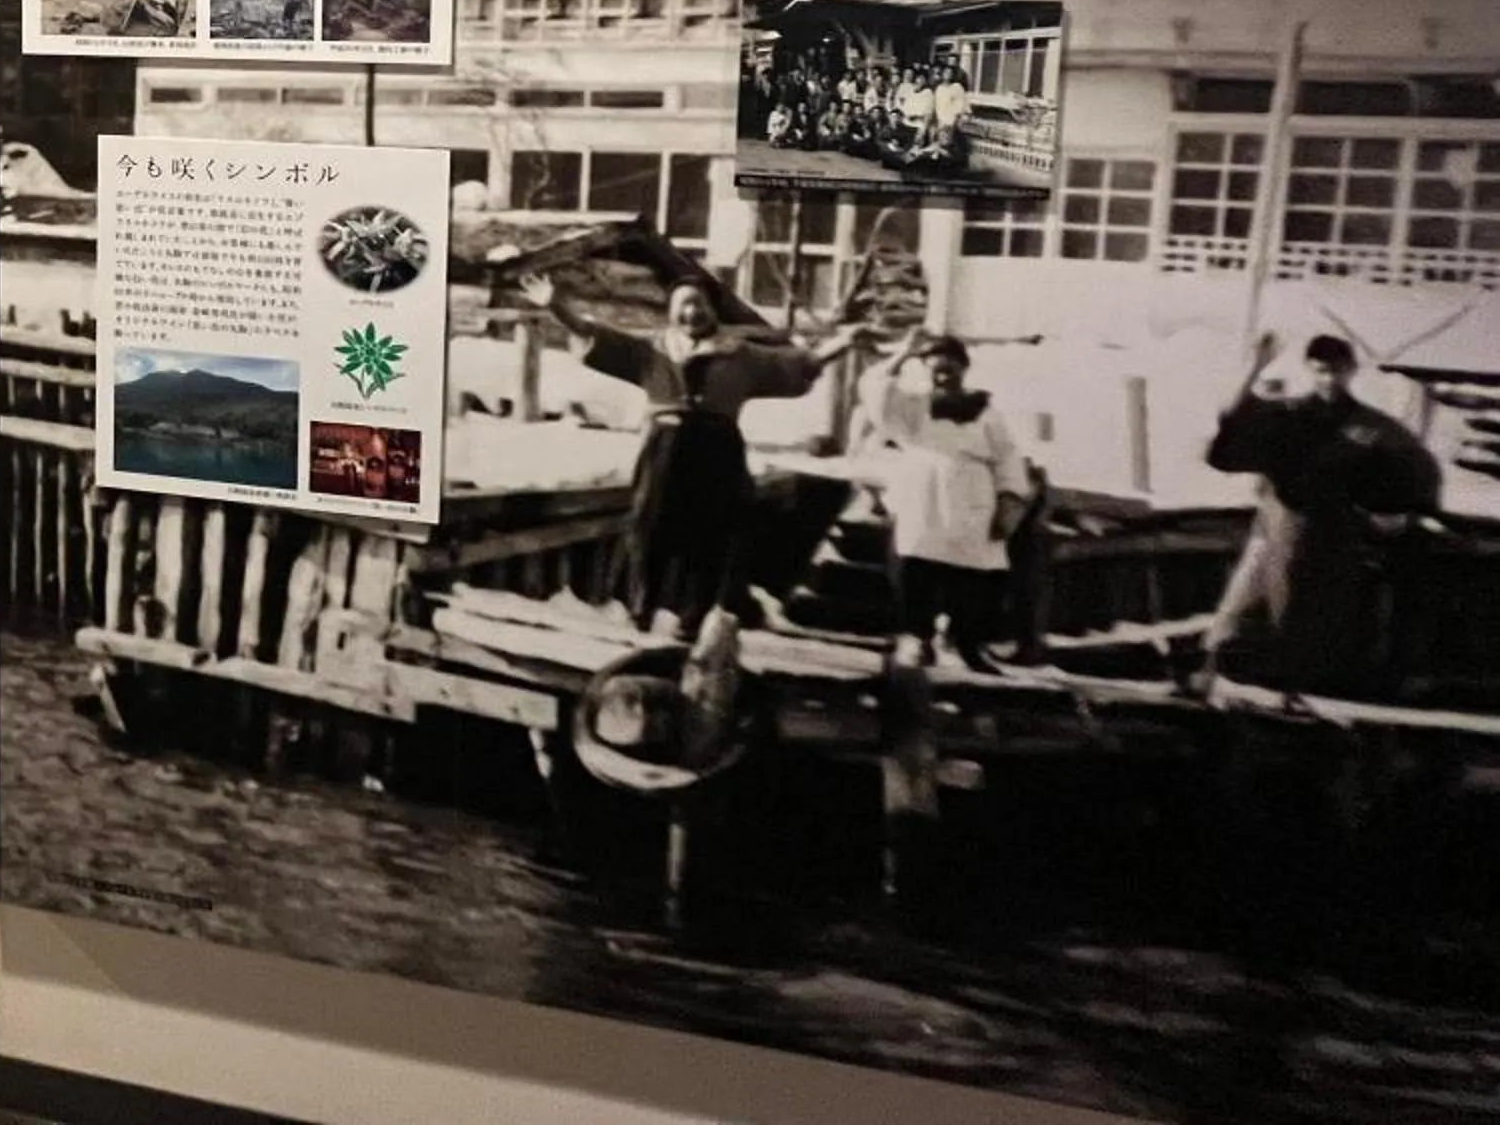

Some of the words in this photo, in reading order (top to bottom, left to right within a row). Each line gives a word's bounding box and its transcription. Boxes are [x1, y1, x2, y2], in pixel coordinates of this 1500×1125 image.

[115, 154, 341, 186] 今も咲くシンボル
